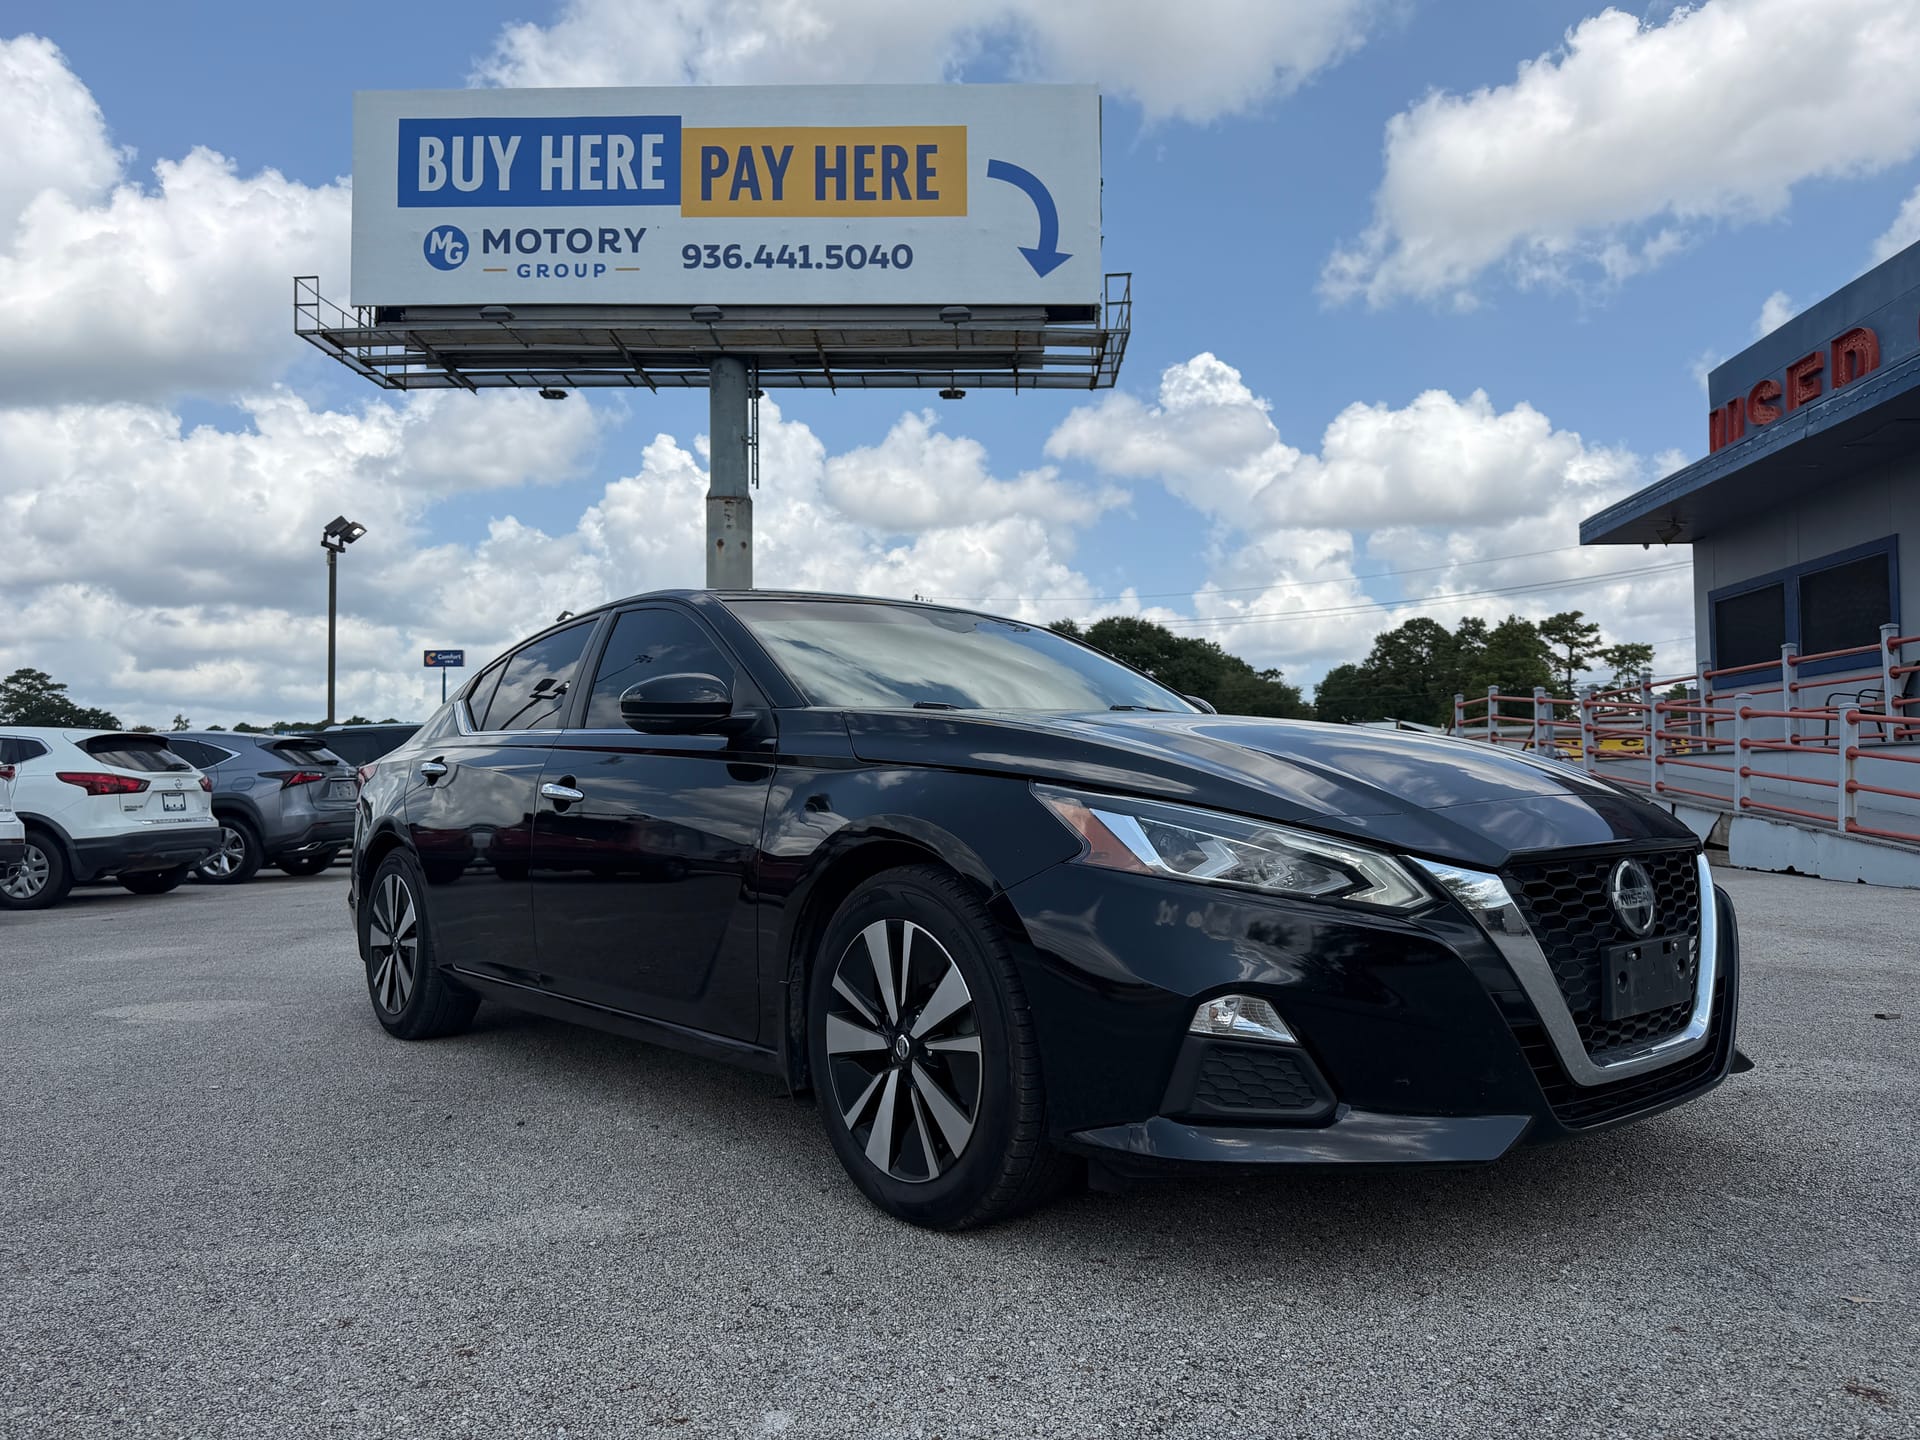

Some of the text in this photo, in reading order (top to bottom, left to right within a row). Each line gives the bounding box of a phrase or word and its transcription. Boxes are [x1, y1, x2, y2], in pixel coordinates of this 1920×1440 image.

[418, 133, 665, 192] BUY HERE
[701, 144, 939, 201] PAY HERE
[430, 231, 464, 265] MG
[482, 227, 647, 254] MOTORY
[516, 263, 606, 278] GROUP
[681, 243, 914, 270] 936.441.5040
